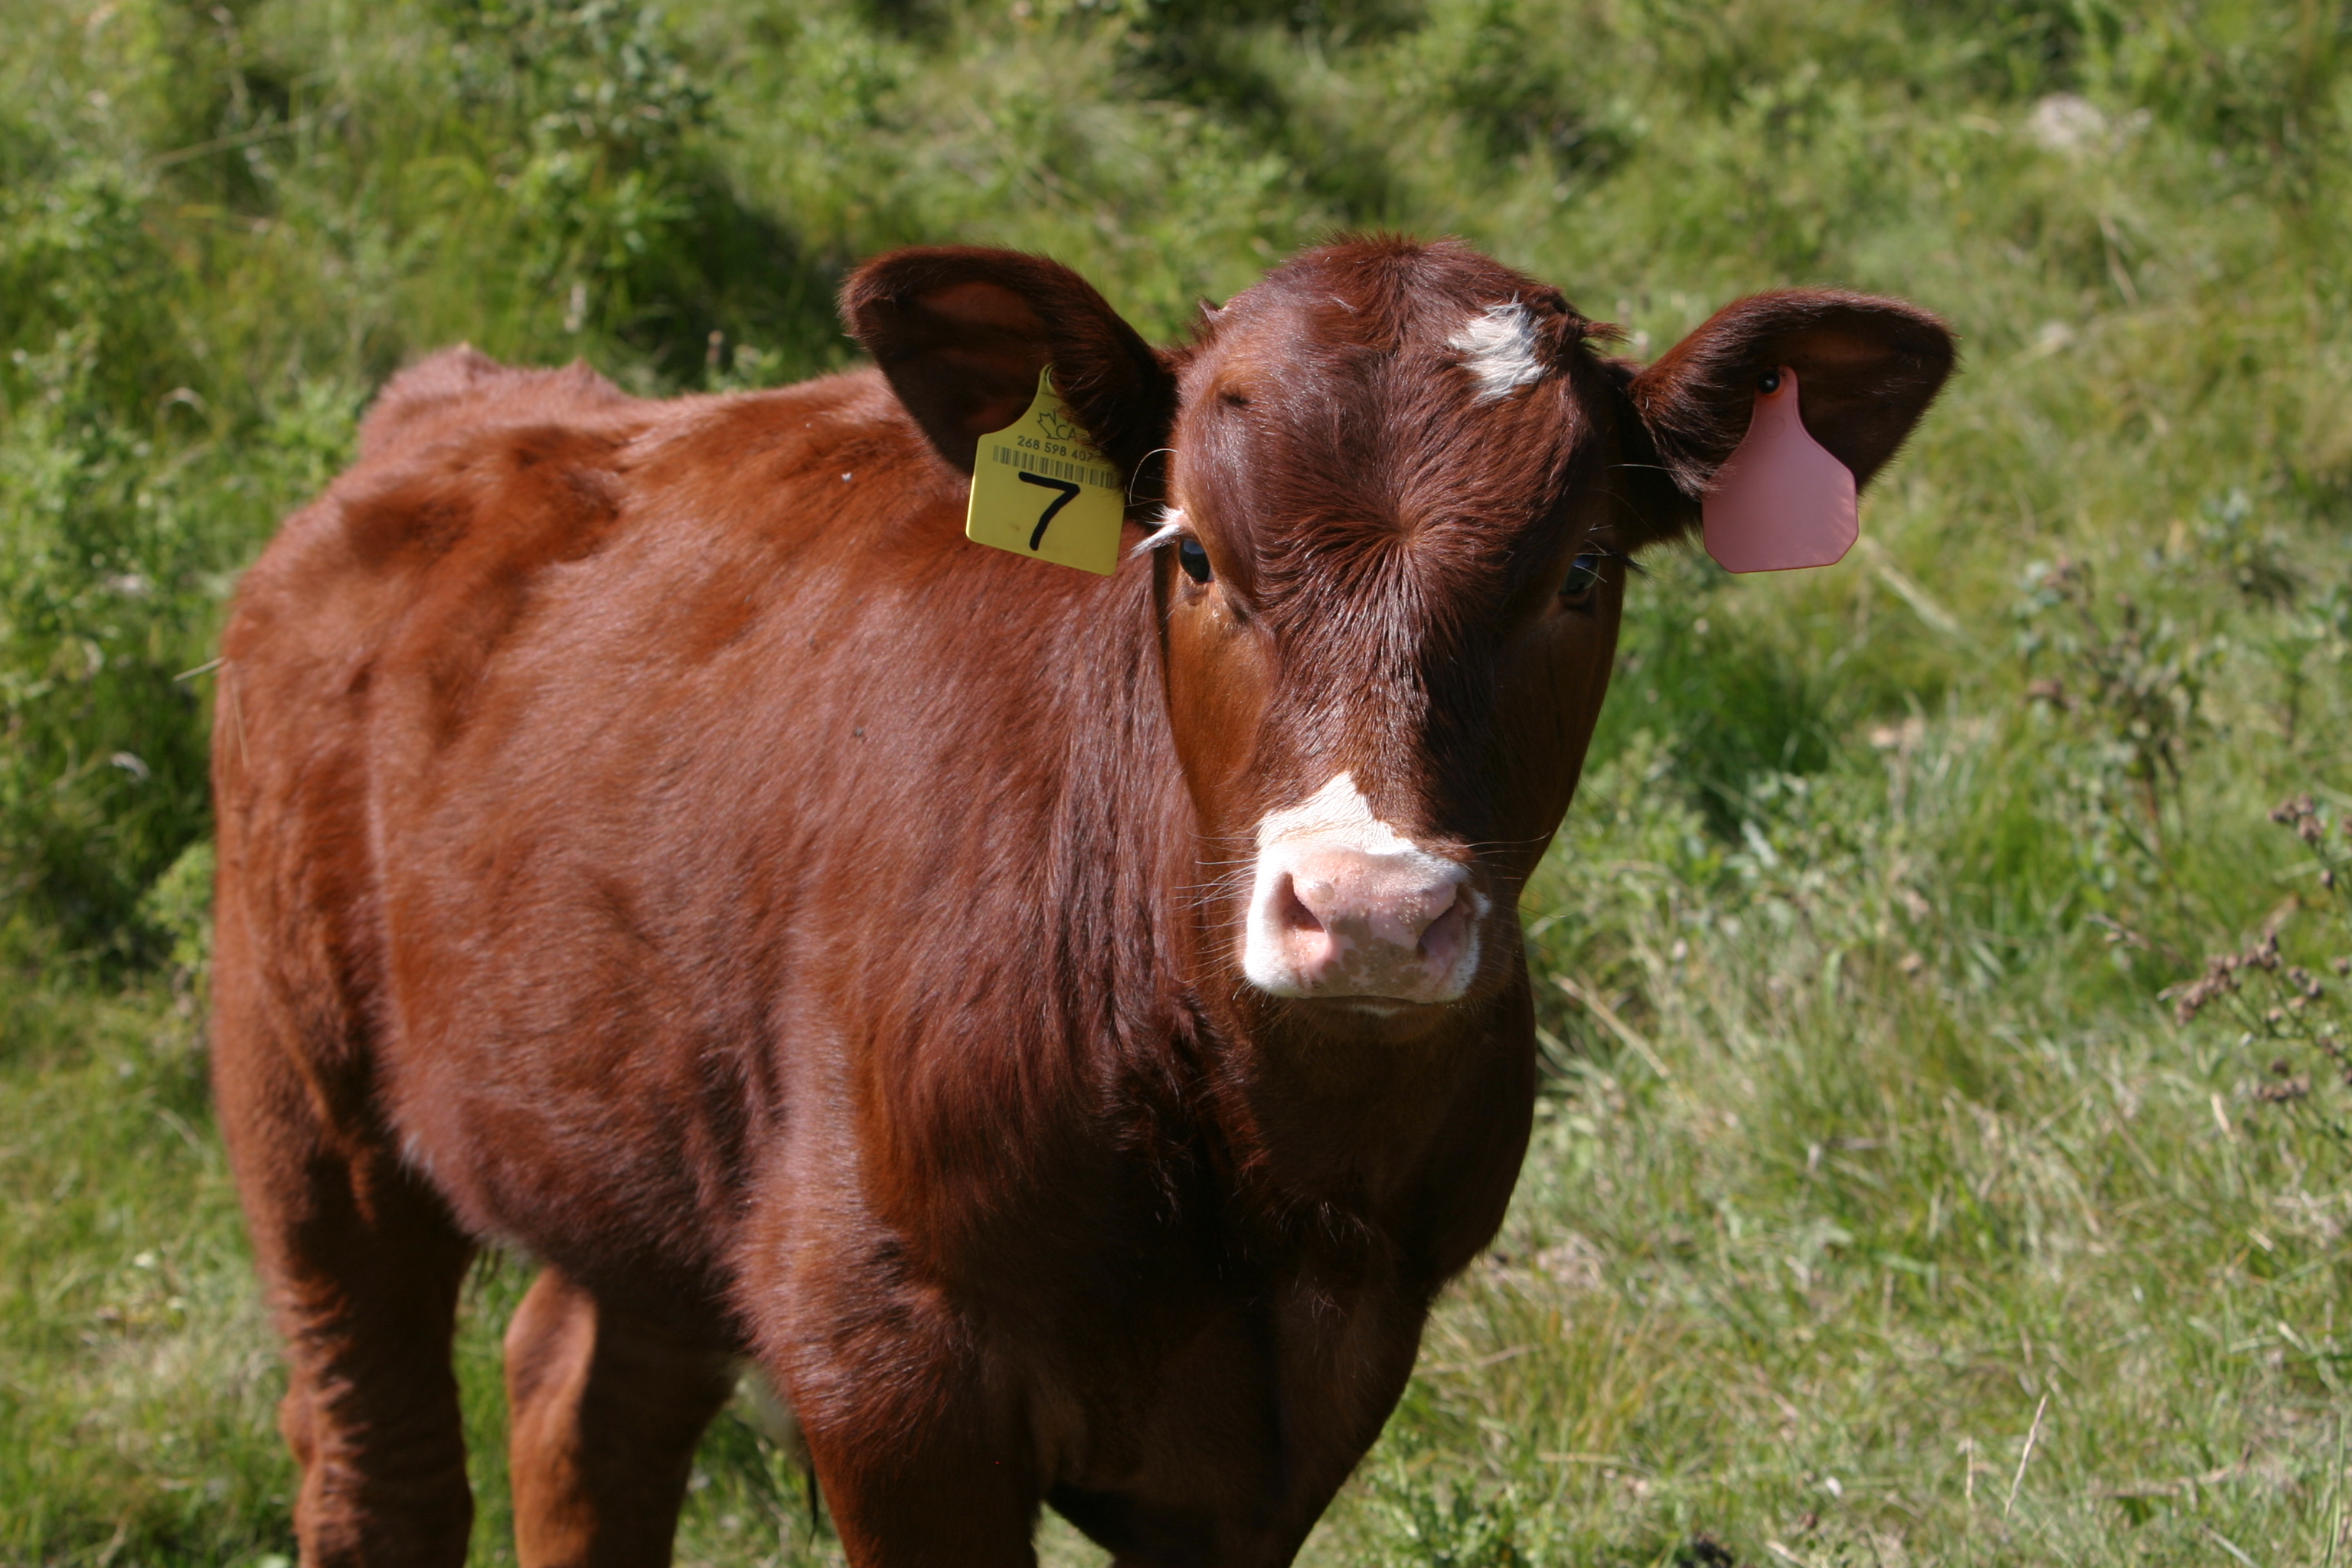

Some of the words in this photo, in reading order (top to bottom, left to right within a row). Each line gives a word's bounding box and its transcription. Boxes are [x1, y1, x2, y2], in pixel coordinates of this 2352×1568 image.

[1018, 436, 1040, 450] 268
[1044, 442, 1067, 456] 598
[1018, 471, 1080, 550] 7
